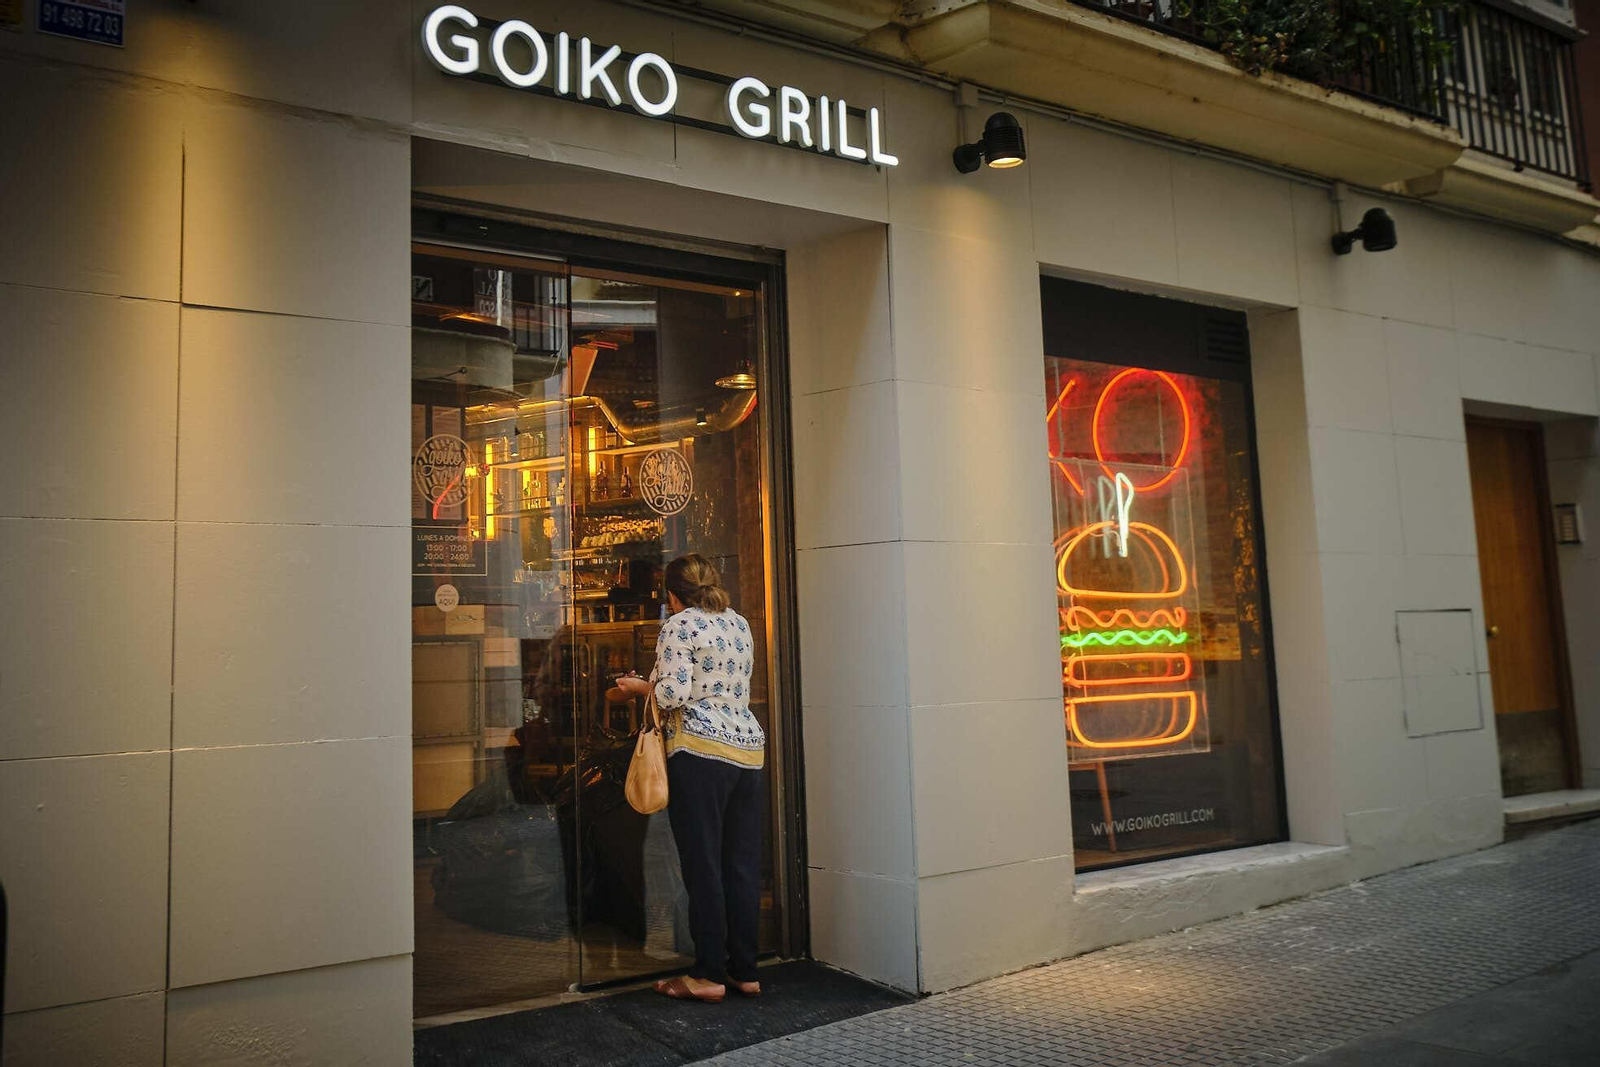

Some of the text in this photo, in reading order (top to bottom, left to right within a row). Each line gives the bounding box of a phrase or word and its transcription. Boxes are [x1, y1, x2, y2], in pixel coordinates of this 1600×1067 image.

[43, 3, 58, 23] 91
[86, 11, 103, 32] 72
[104, 15, 119, 36] 03
[422, 4, 899, 167] GOIKO GRILL
[1091, 808, 1214, 836] WWW.GOIKOGRILL.COM
